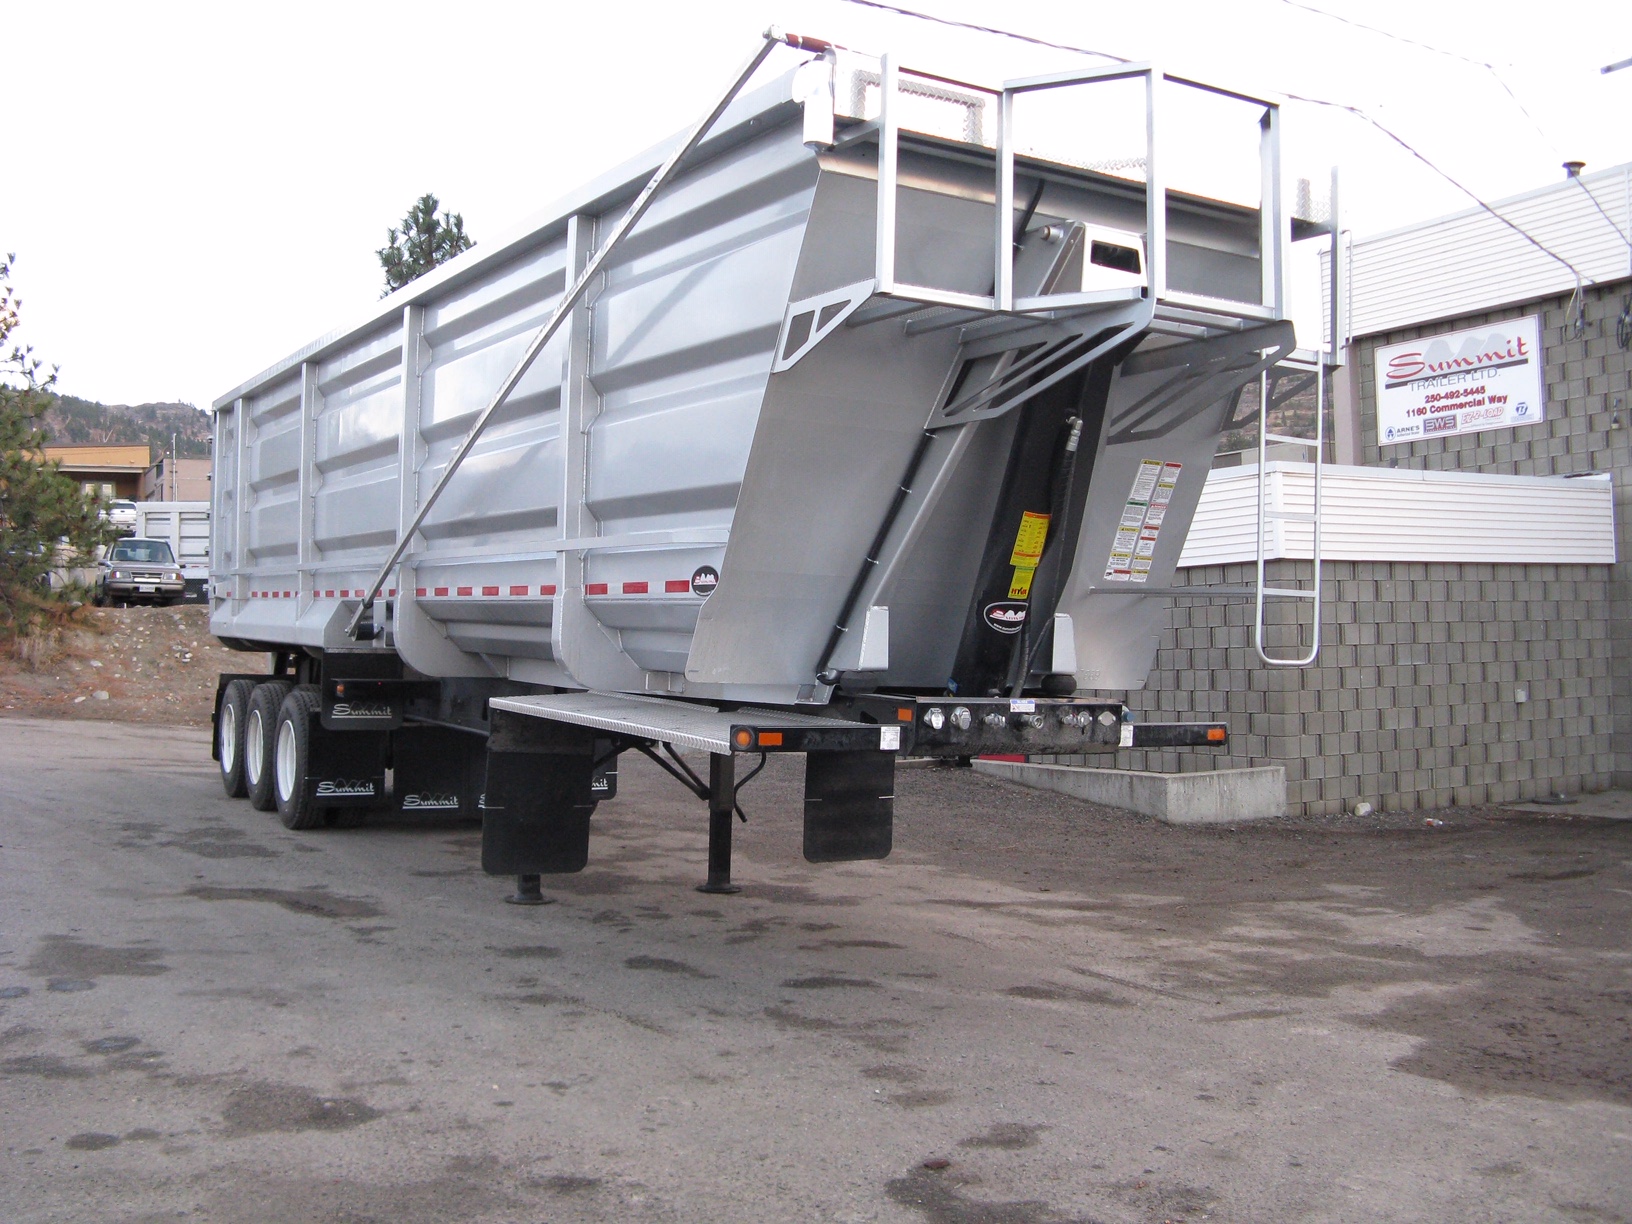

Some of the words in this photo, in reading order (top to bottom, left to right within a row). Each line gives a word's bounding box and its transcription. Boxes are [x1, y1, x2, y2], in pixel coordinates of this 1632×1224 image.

[1386, 336, 1529, 380] Summit
[1409, 373, 1467, 392] TRAILER
[1471, 368, 1501, 382] LTD.
[1424, 385, 1486, 404] 250-492-5445
[1429, 398, 1485, 415] Commercial
[1488, 394, 1508, 405] Way
[332, 703, 392, 716] Summit
[316, 781, 374, 793] Summit
[403, 794, 459, 806] Summit
